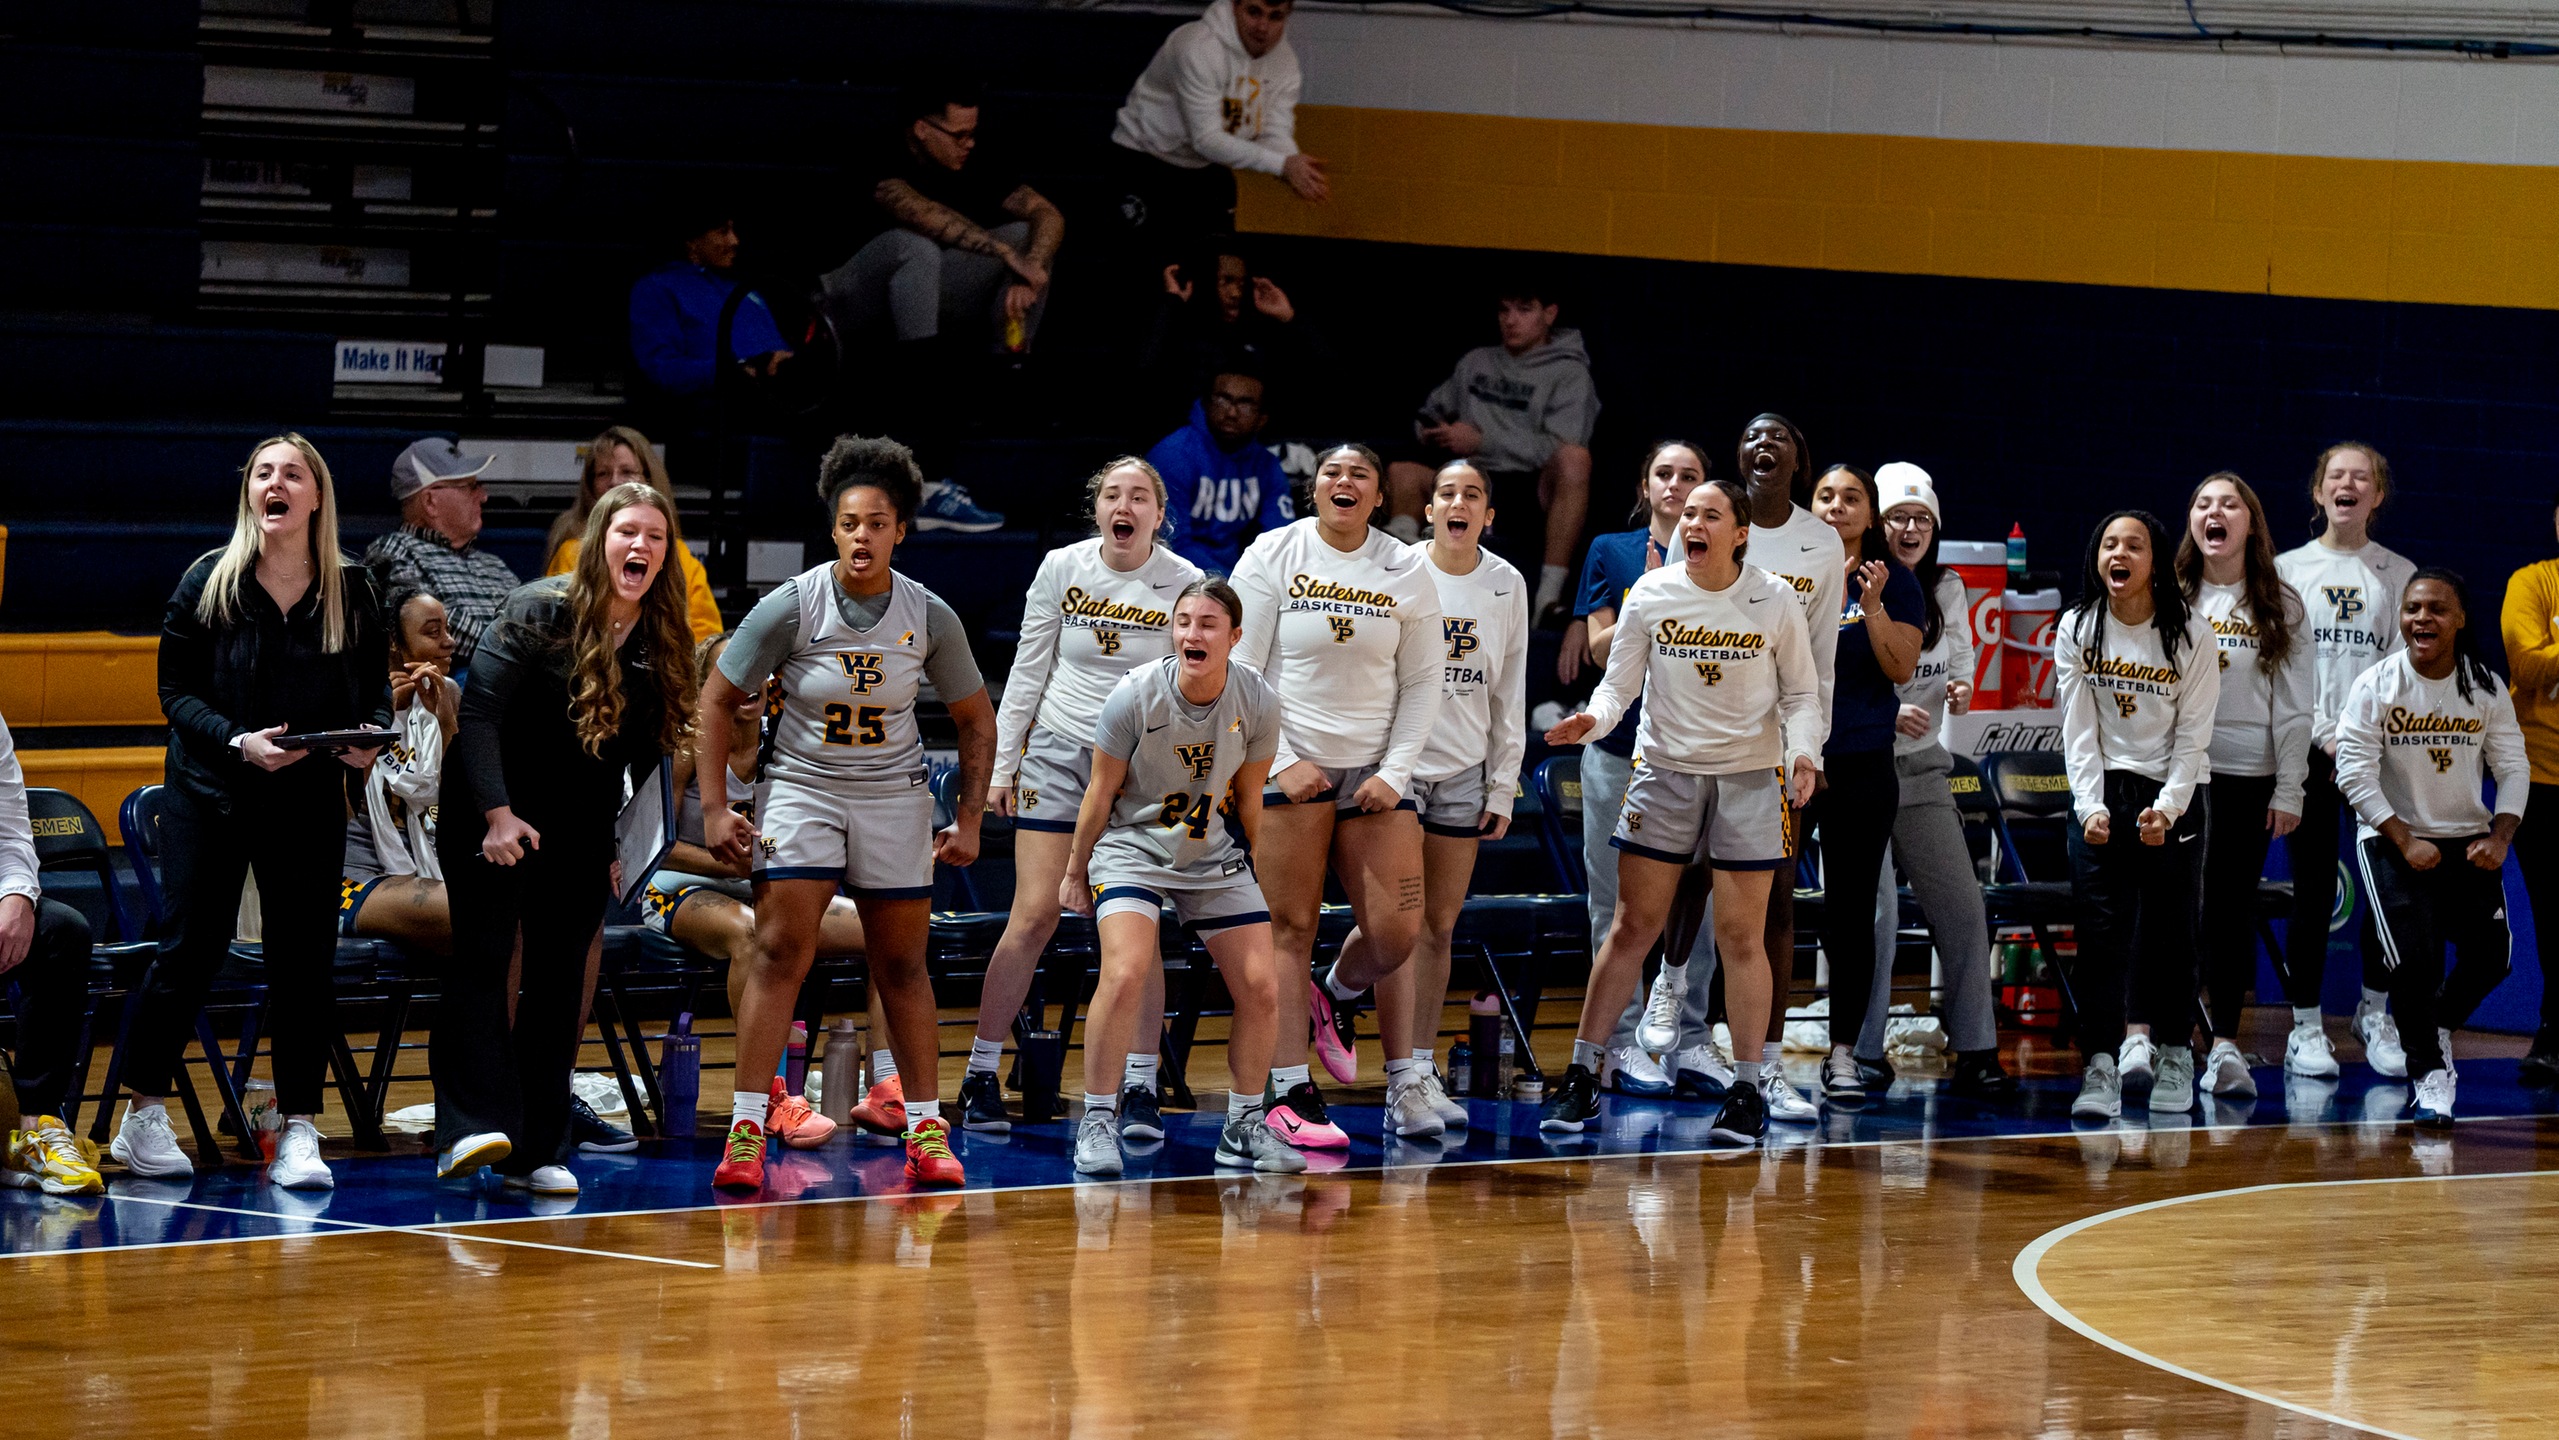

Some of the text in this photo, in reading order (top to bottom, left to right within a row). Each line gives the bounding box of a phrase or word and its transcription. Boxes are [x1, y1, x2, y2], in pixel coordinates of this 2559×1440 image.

[343, 348, 389, 370] Make
[396, 349, 407, 371] It
[1190, 475, 1259, 522] RUN
[1288, 574, 1398, 608] Statesmen
[2321, 585, 2366, 623] WP
[1061, 586, 1170, 628] Statesmen
[1290, 600, 1391, 618] BASKETBALL
[1093, 628, 1121, 656] WP
[1326, 615, 1355, 643] WP
[1656, 619, 1765, 649] Statesmen
[1659, 645, 1759, 660] BASKETBALL
[836, 651, 887, 696] WP
[1694, 662, 1723, 687] WP
[2113, 691, 2138, 719] WP
[823, 702, 888, 746] 25
[2427, 748, 2454, 774] WP
[1022, 789, 1038, 809] WP
[1158, 791, 1214, 841] 24
